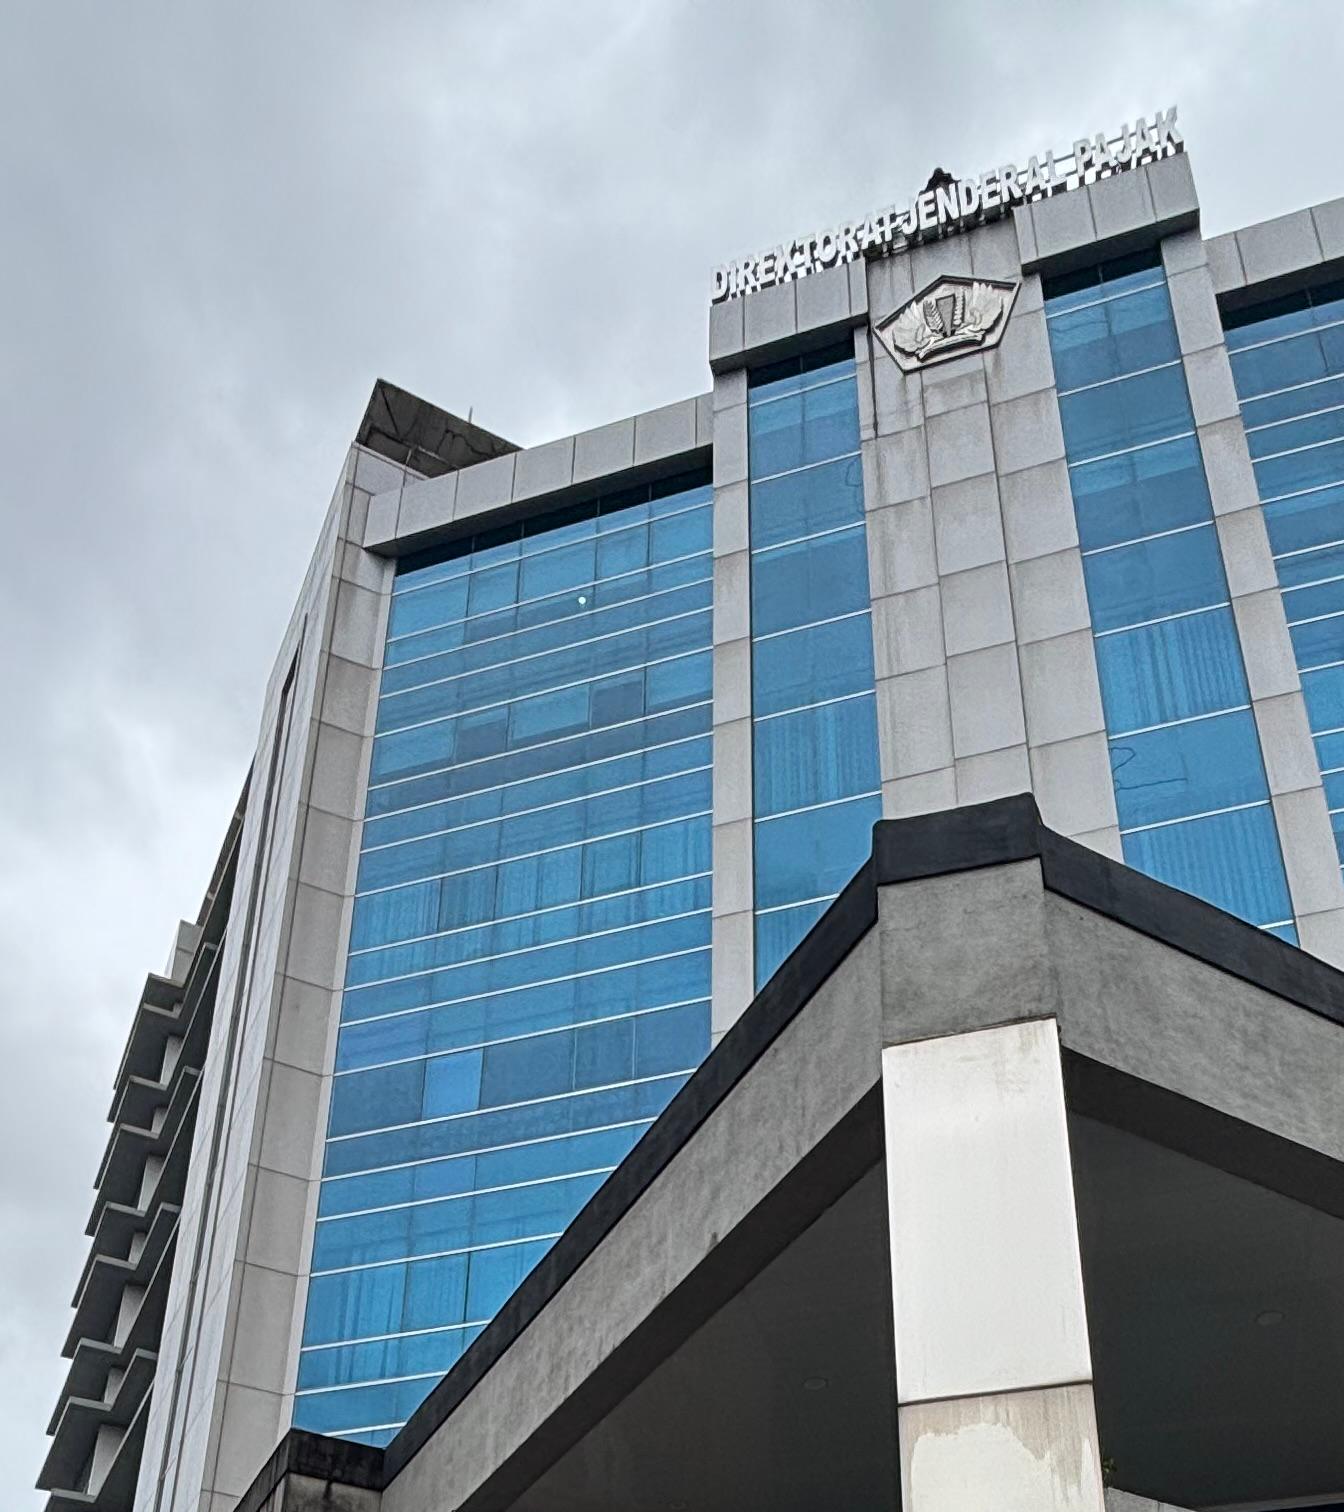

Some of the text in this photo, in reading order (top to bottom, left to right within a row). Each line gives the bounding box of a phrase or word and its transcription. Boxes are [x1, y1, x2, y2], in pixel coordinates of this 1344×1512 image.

[710, 104, 1185, 300] DIREKTORAT JENDERAL PAJAK
